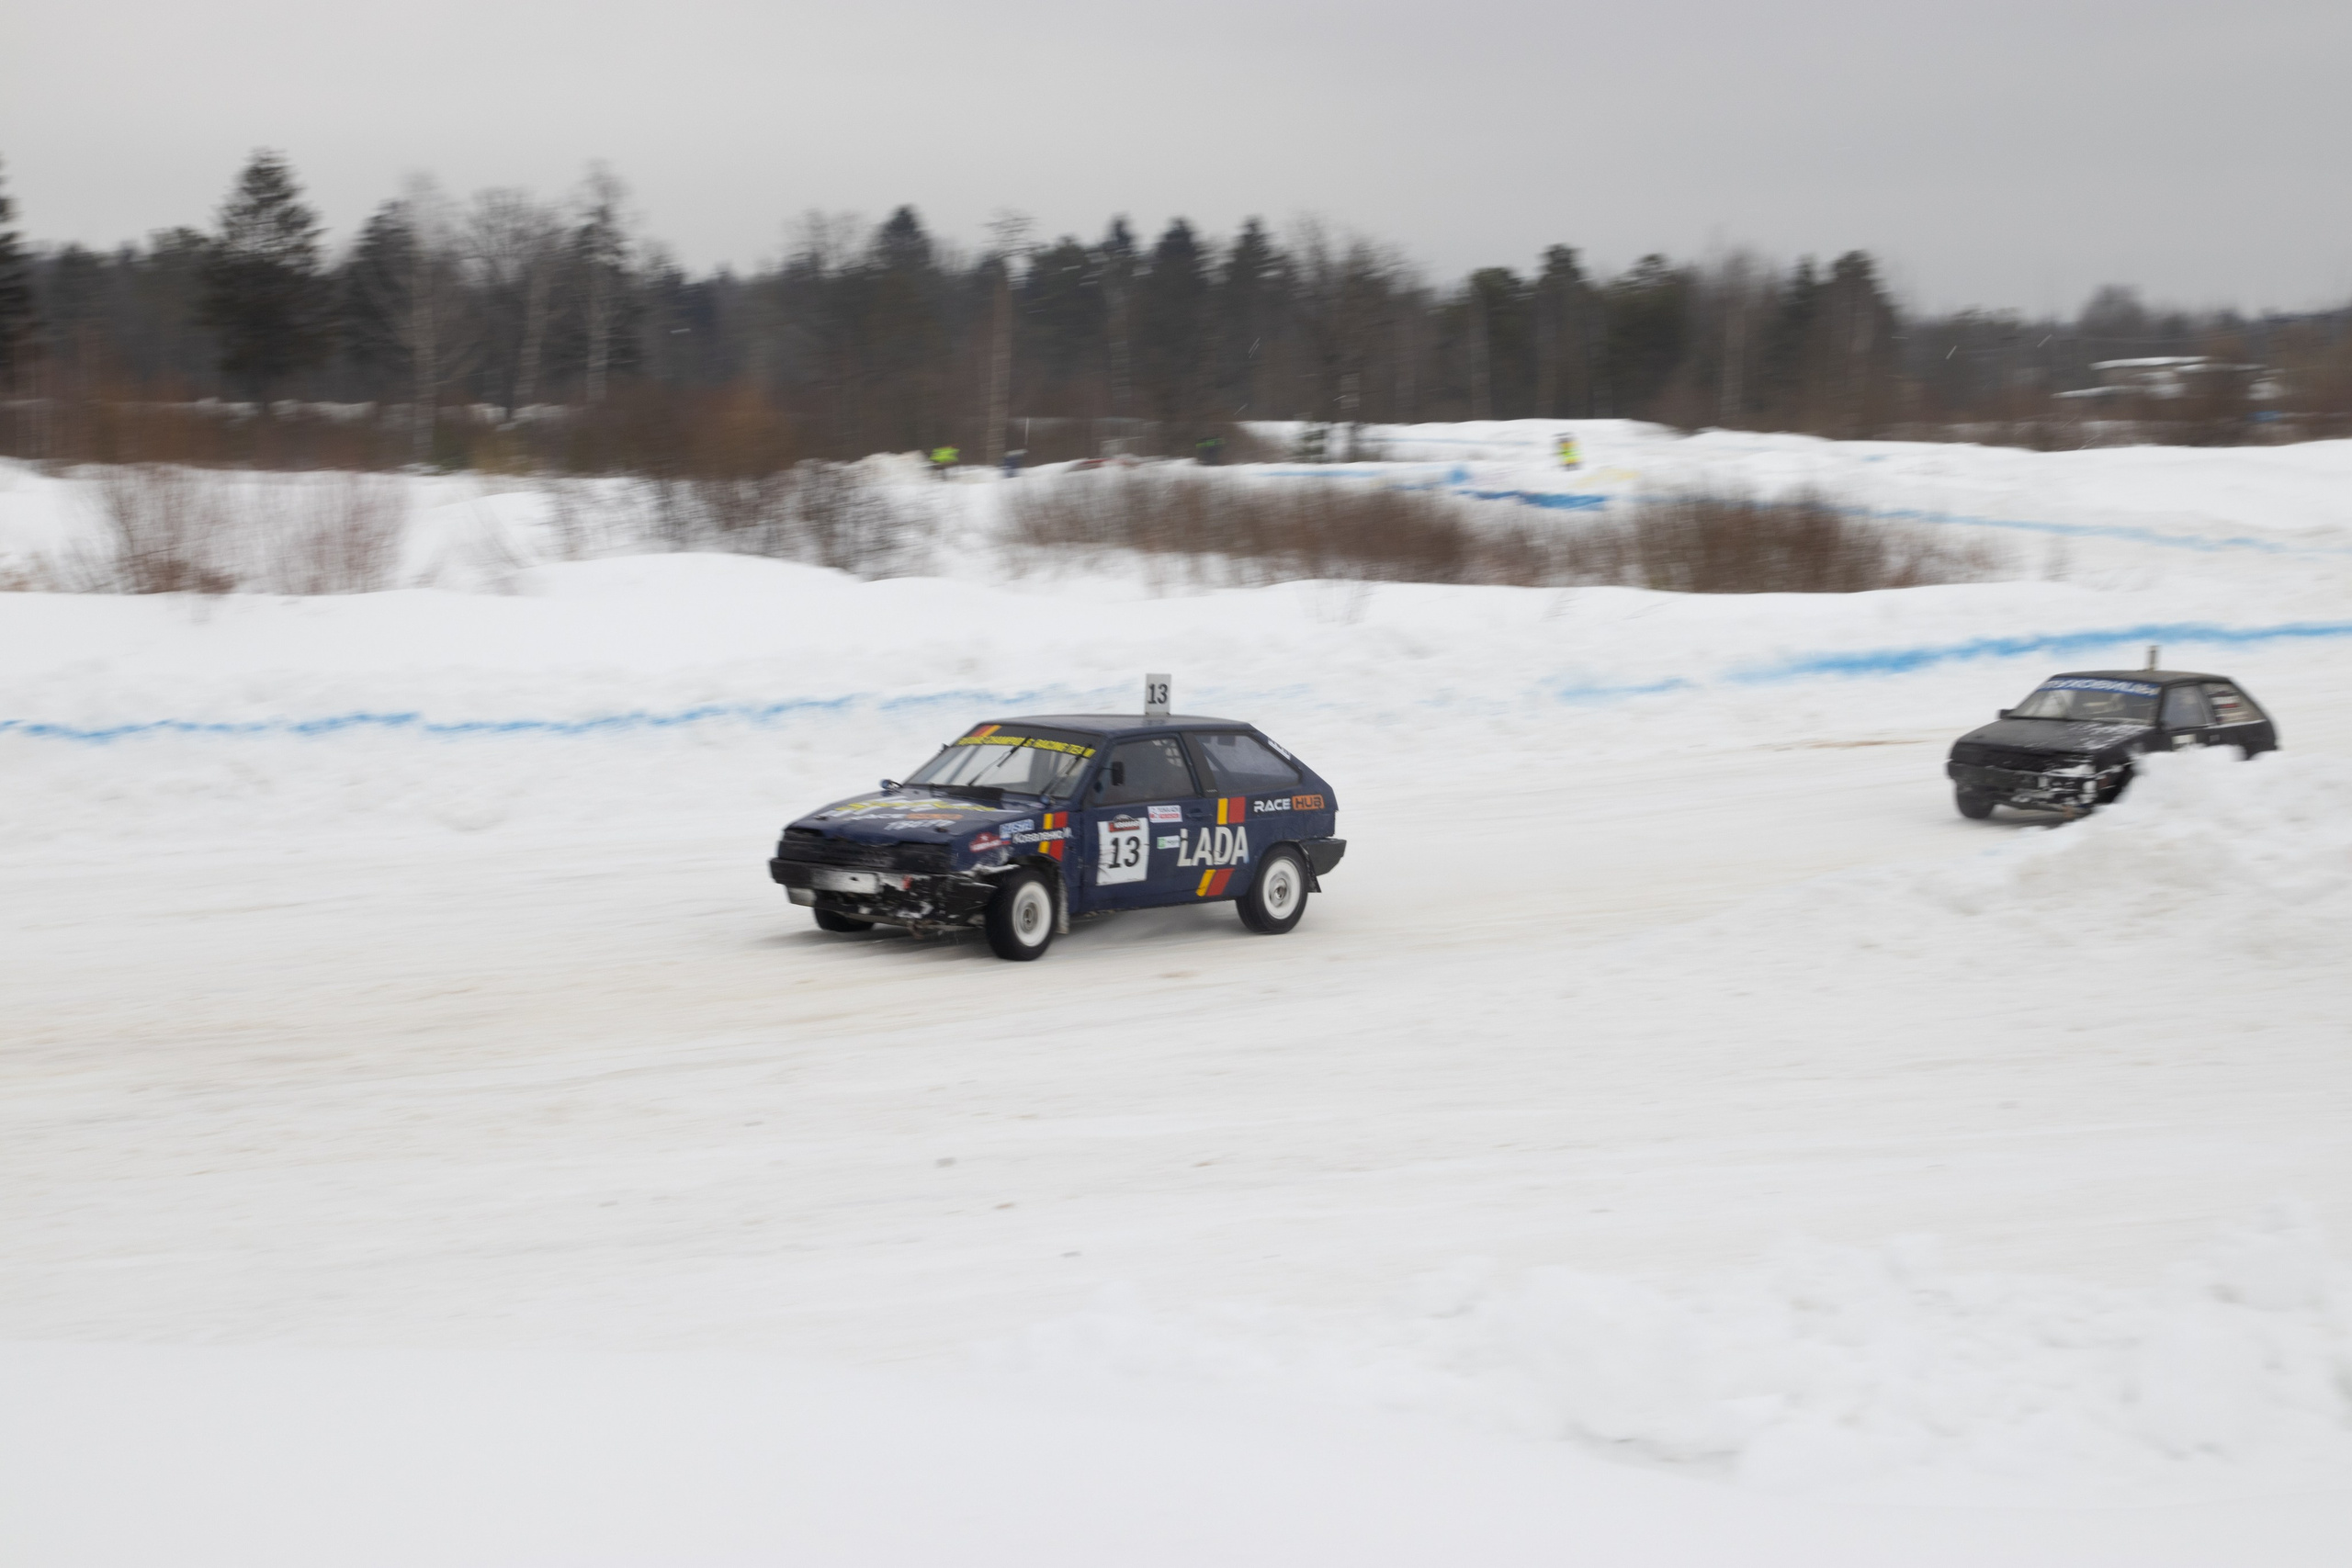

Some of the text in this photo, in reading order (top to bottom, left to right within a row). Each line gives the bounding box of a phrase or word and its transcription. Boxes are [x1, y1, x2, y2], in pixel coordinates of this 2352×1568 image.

[1148, 683, 1169, 705] 13
[1253, 796, 1322, 813] RACE HUB
[1108, 836, 1141, 869] 13
[1177, 826, 1250, 867] LADA
